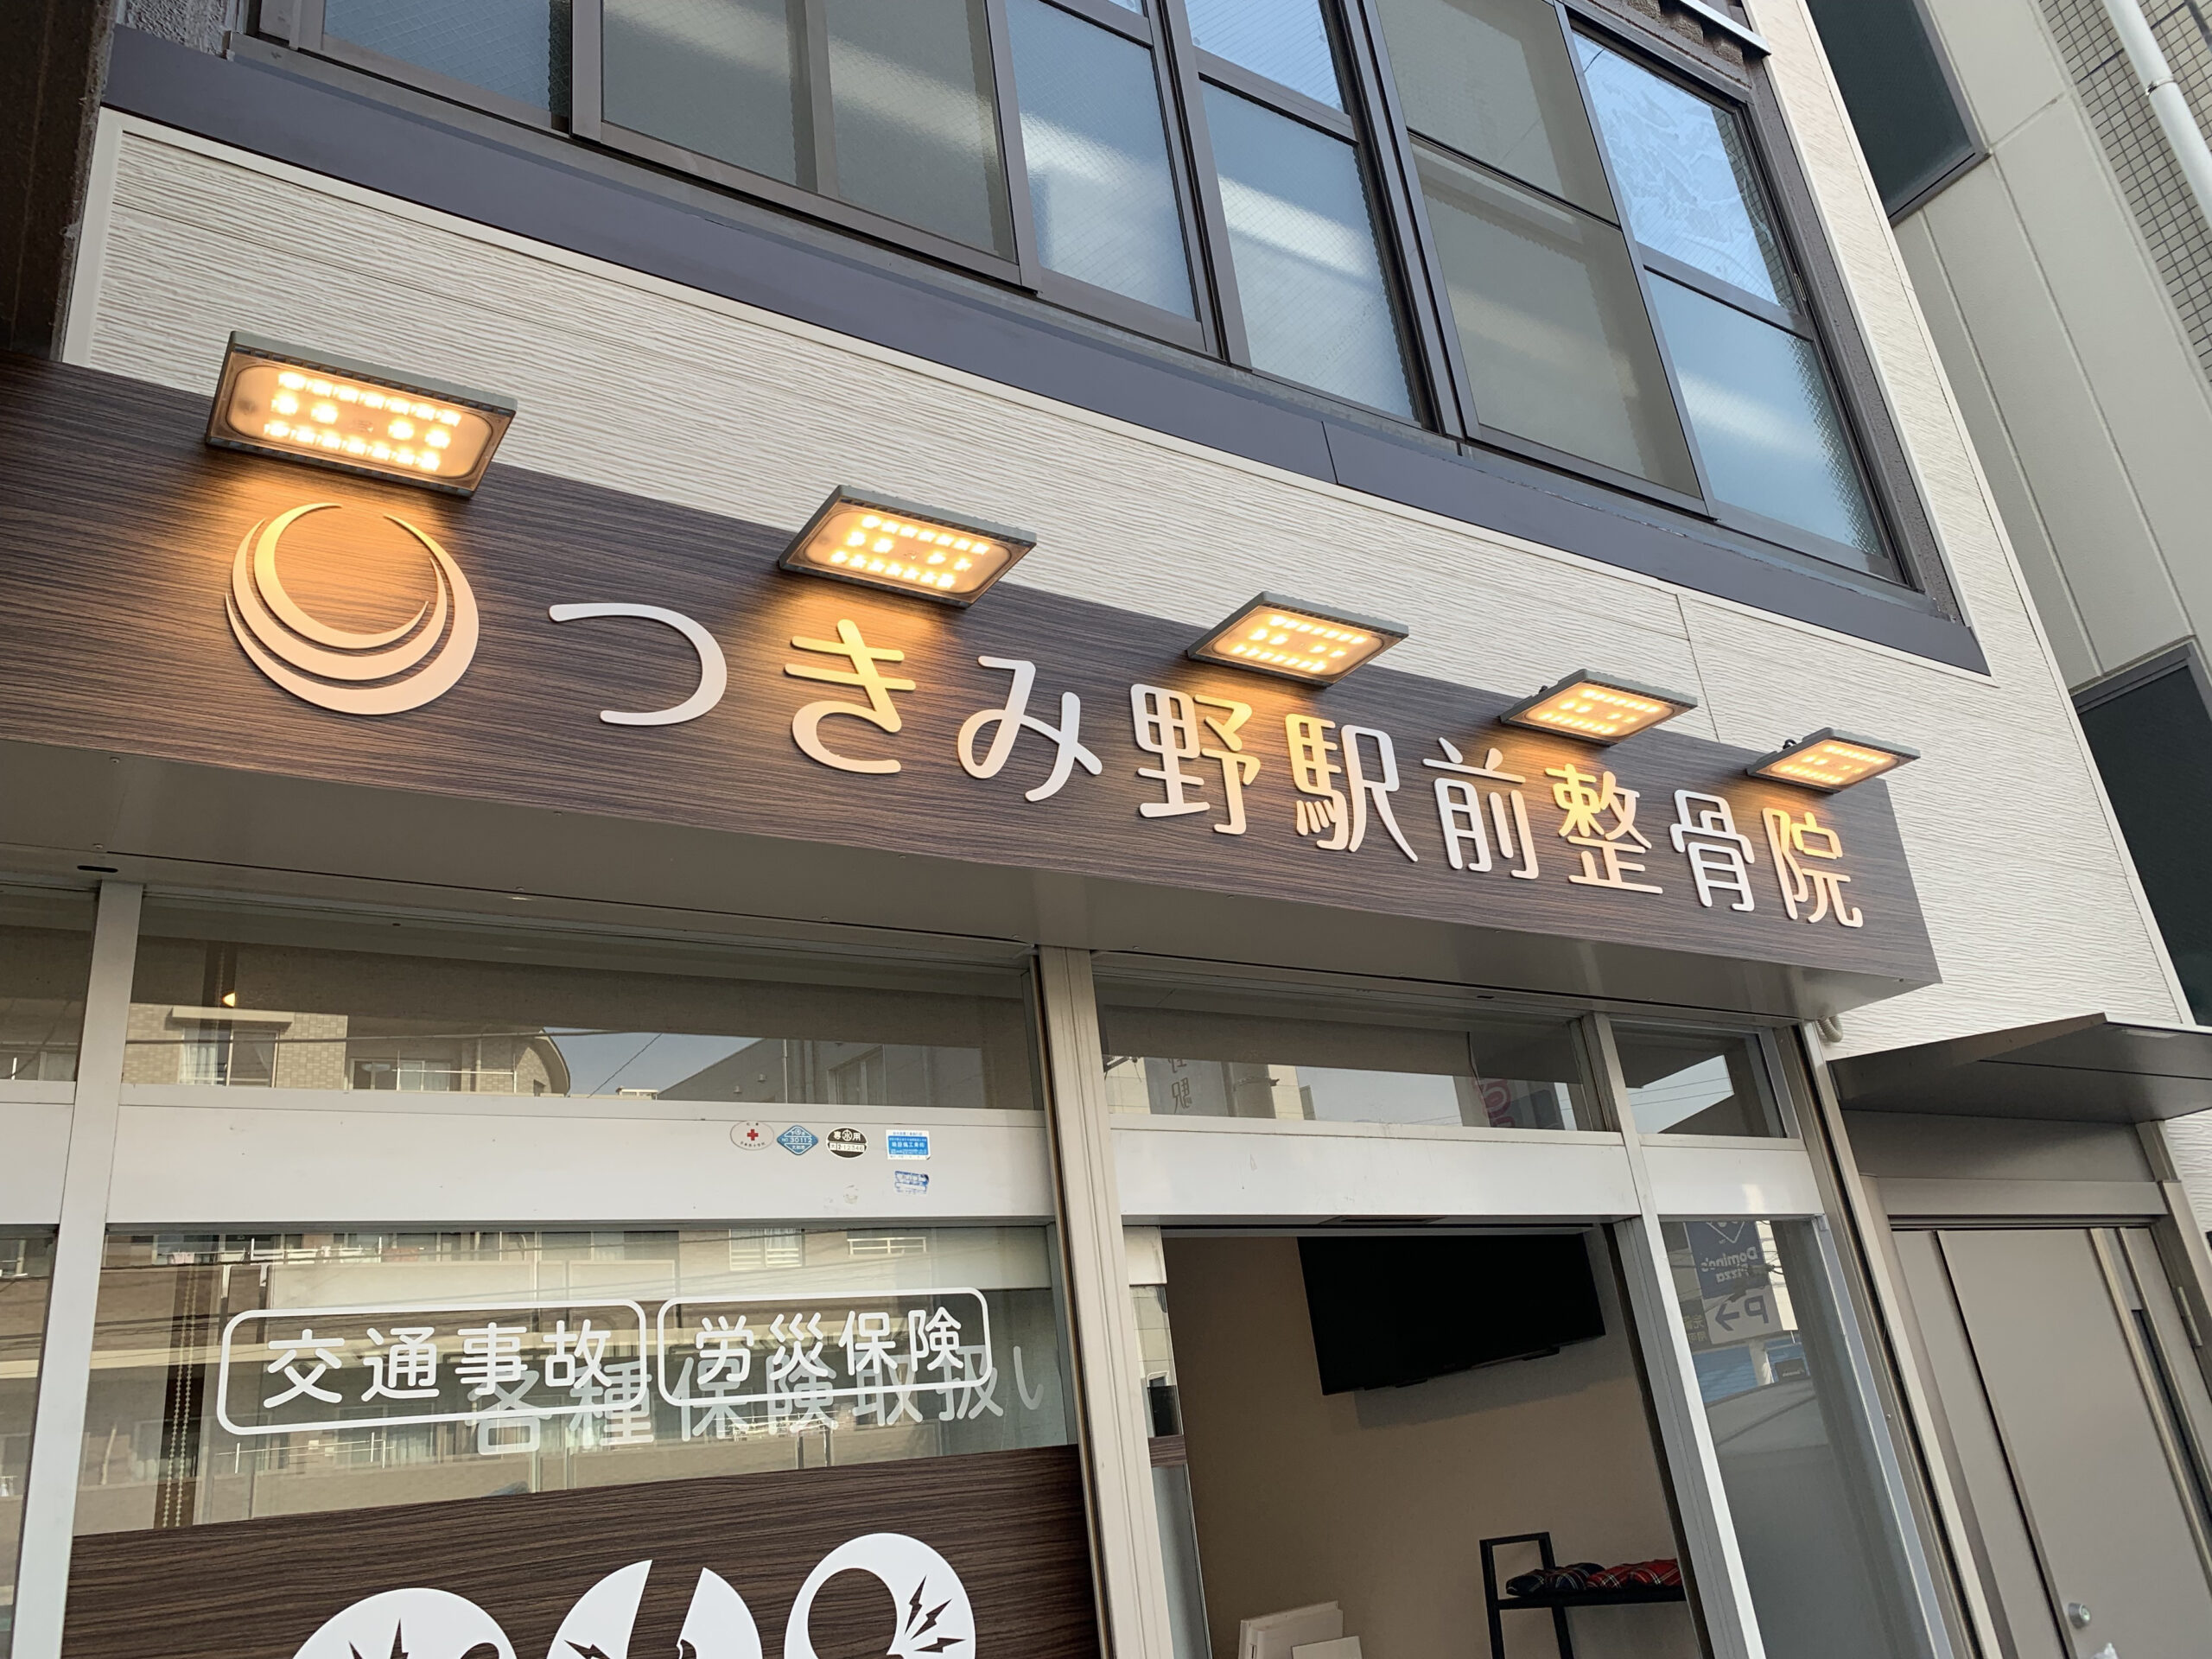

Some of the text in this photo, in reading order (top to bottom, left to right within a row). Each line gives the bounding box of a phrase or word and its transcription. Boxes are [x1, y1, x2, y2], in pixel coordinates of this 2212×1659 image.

[548, 601, 1865, 930] つきみ野駅前整骨院
[264, 1319, 615, 1408] 交通事故
[695, 1306, 965, 1388] 労災保険
